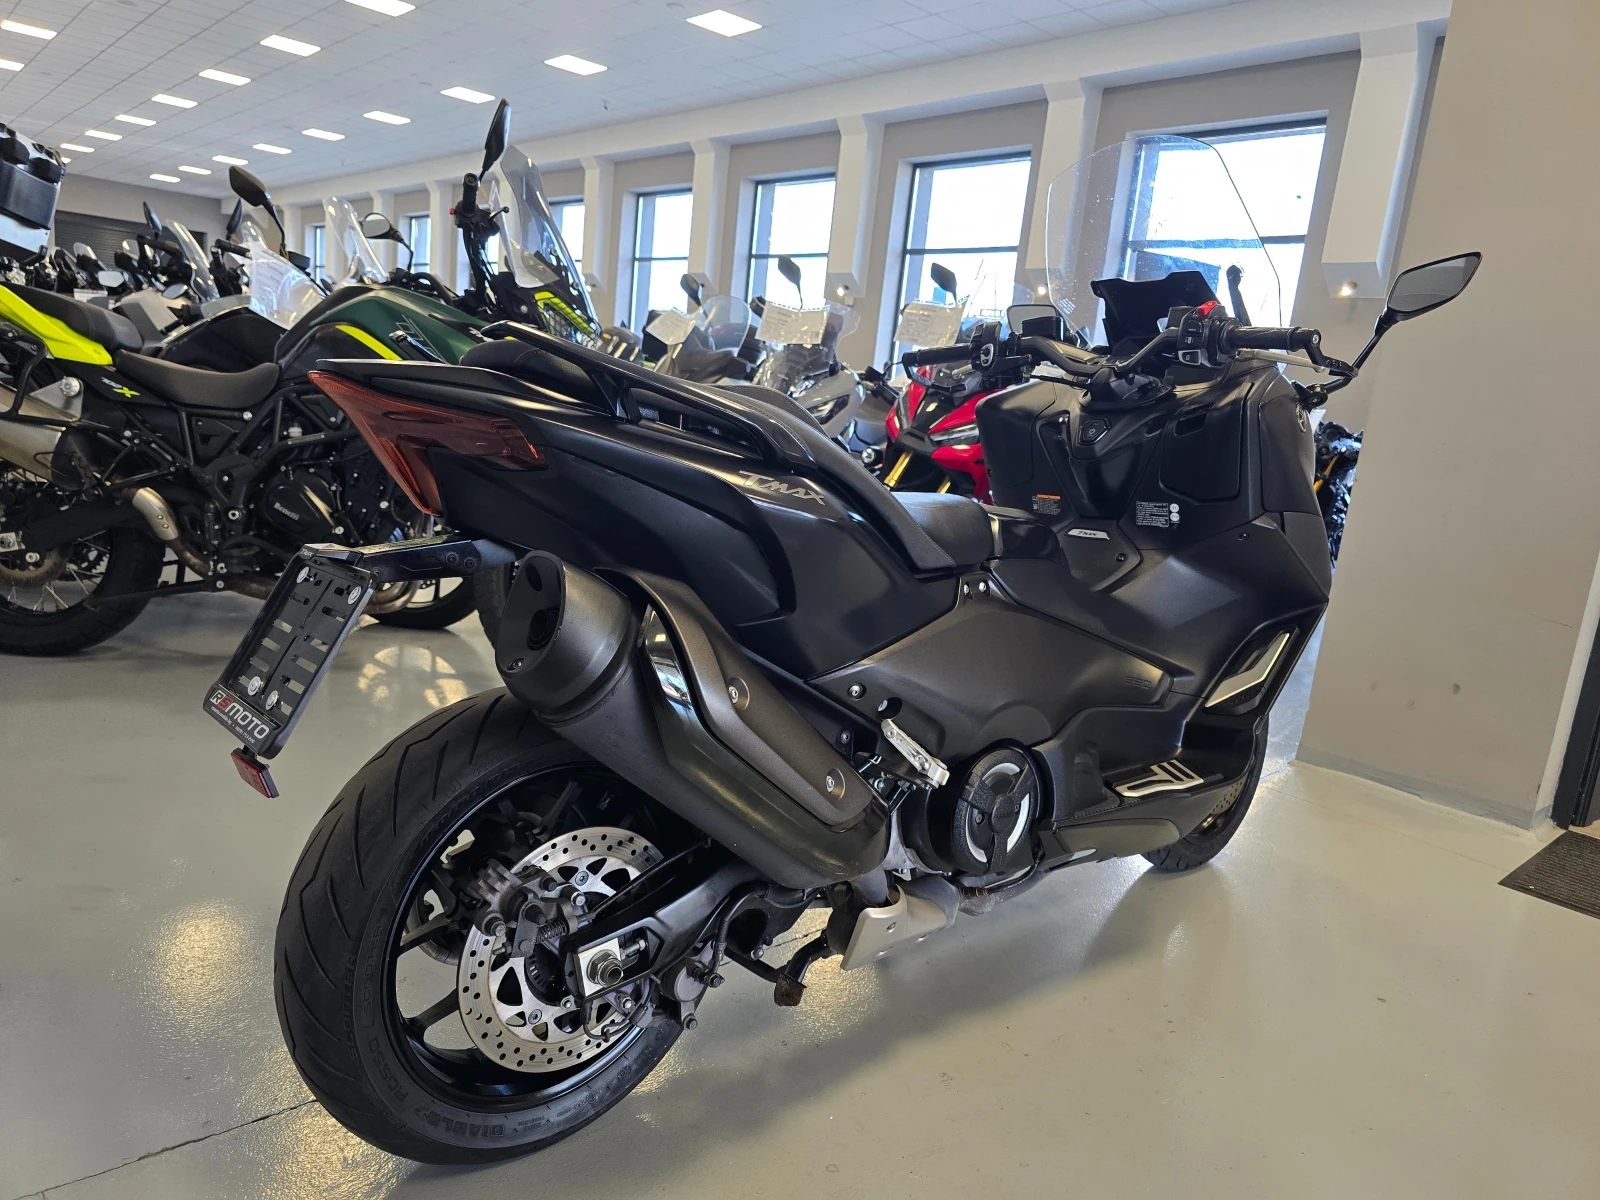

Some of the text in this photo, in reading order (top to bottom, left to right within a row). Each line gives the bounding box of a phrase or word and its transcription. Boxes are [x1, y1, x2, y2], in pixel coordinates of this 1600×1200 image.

[739, 470, 825, 505] TMAX
[273, 502, 300, 521] Benelli
[368, 1036, 408, 1102] ROSSO
[426, 1111, 505, 1137] DIABLO
